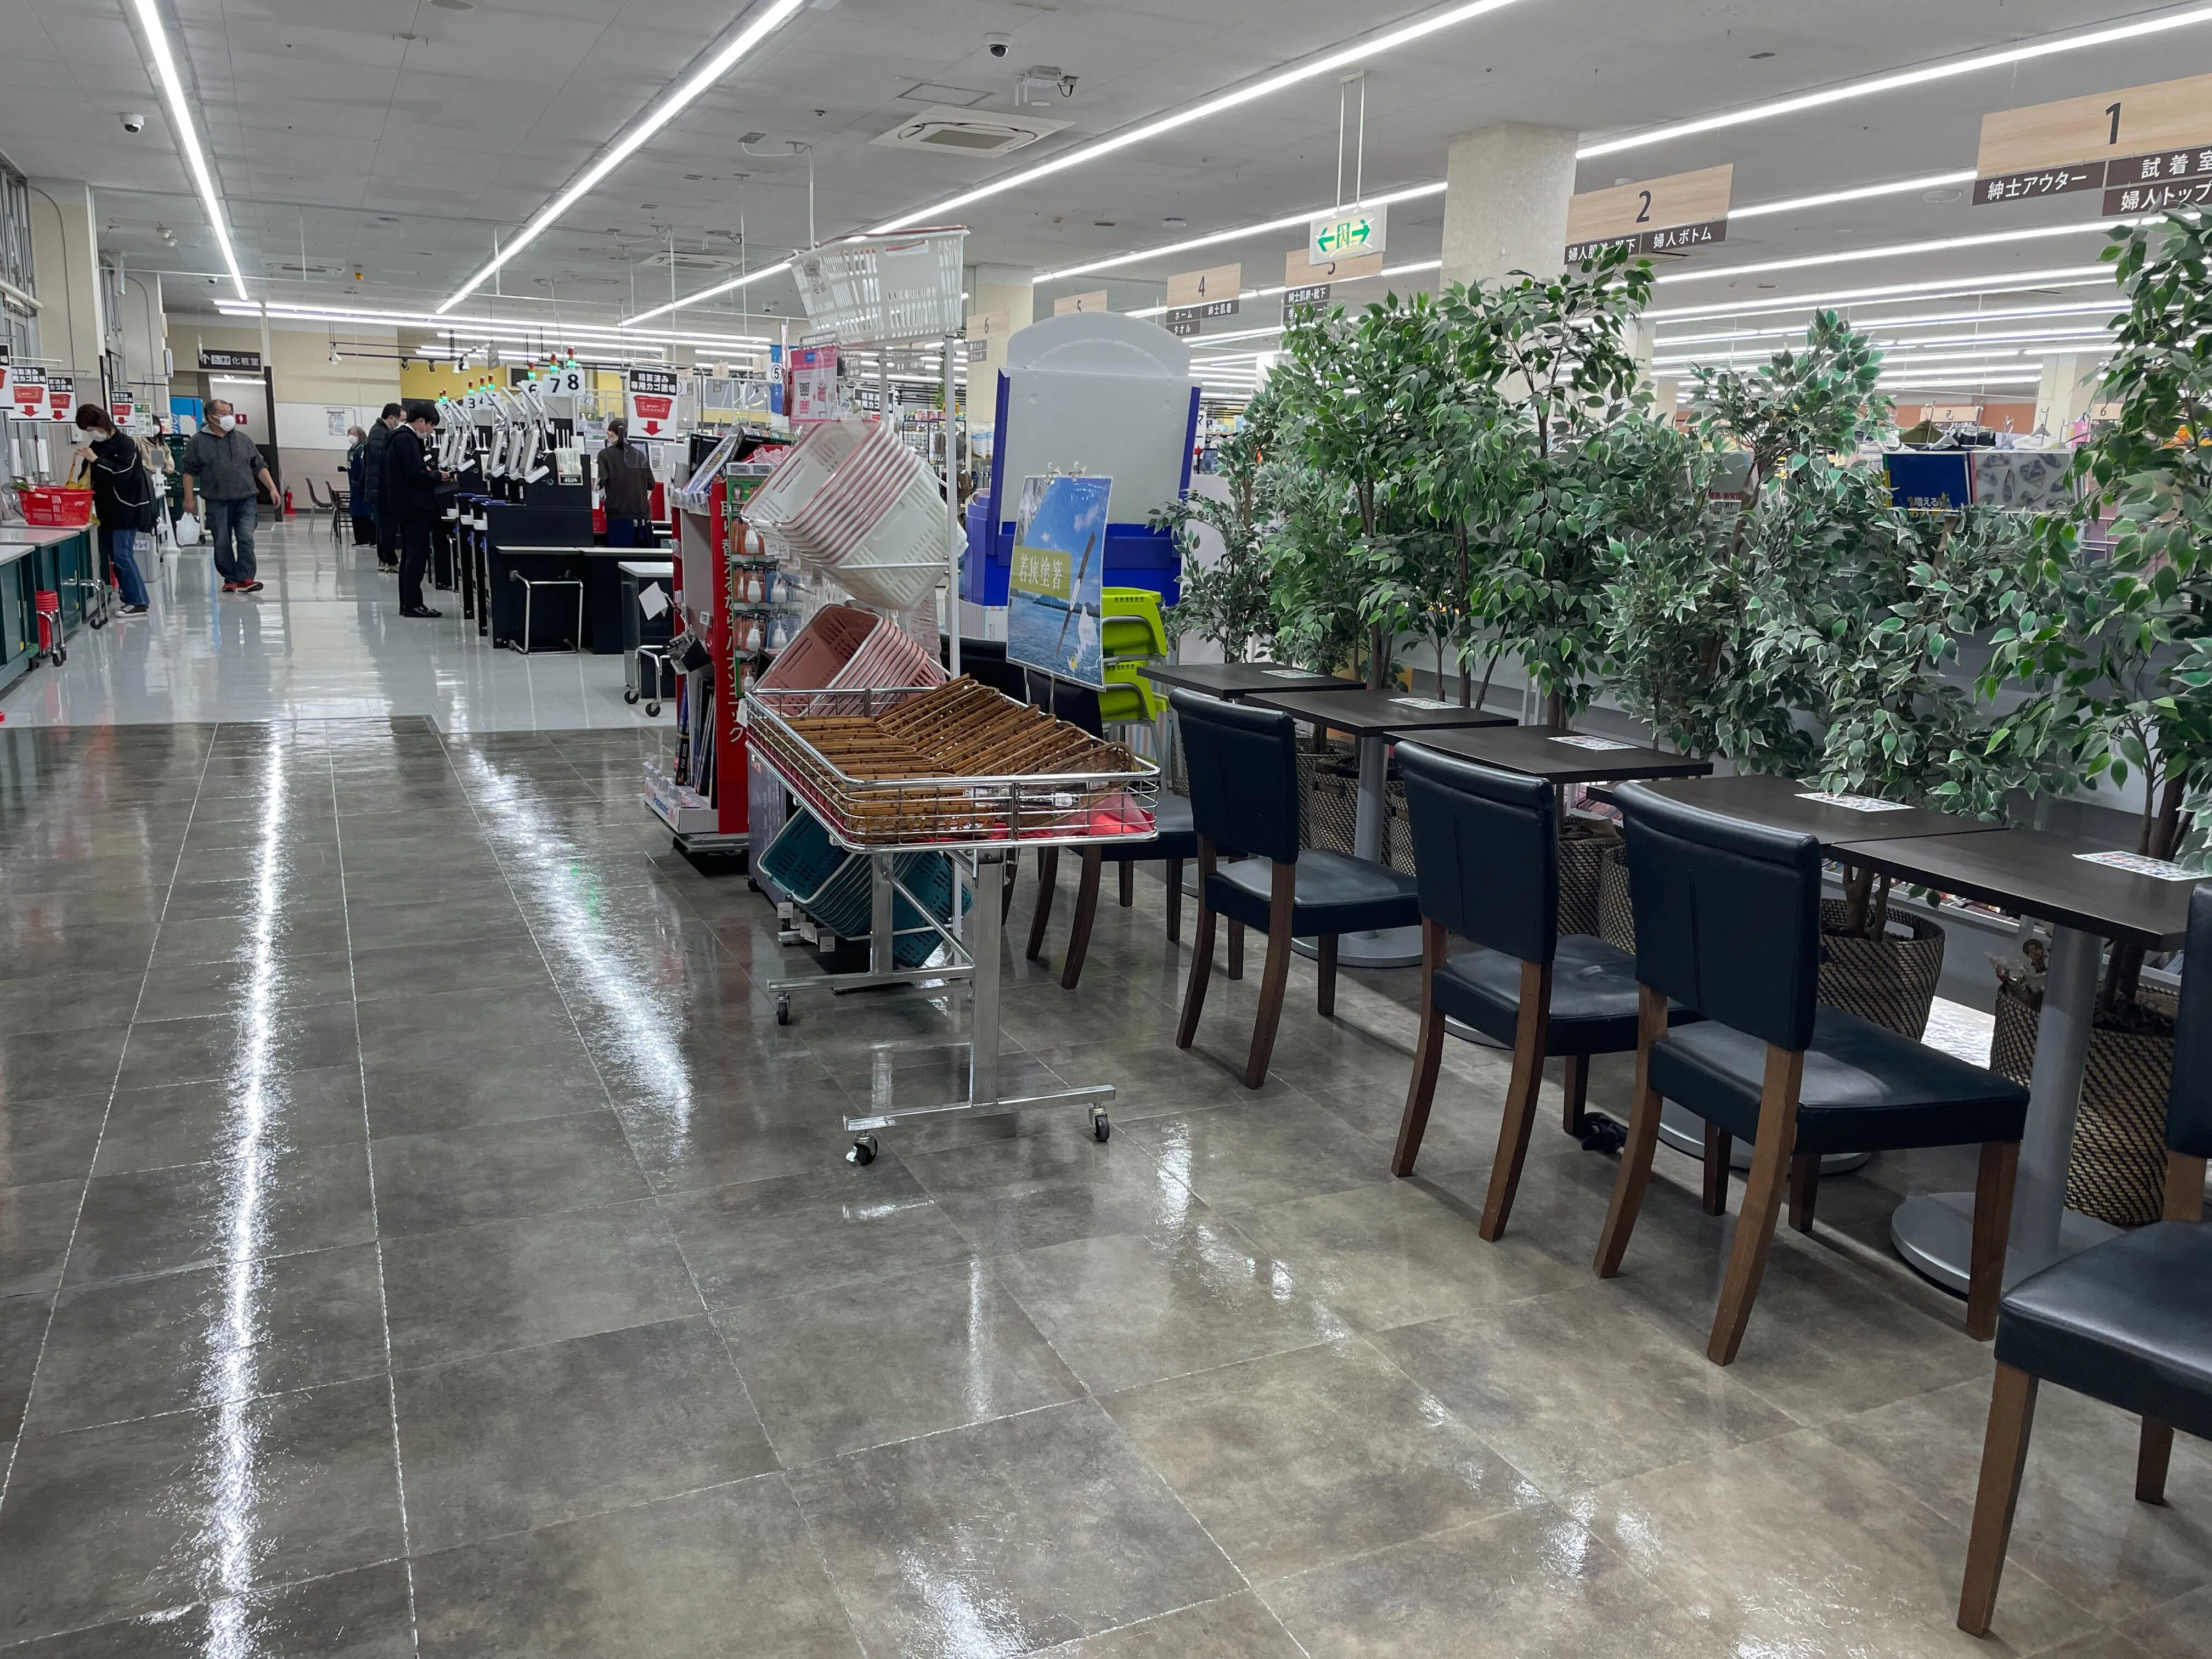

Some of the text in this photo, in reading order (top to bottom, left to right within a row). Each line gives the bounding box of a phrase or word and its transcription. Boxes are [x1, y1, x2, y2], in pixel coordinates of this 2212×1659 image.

[2105, 102, 2121, 145] 1
[2141, 149, 2212, 180] 試着室
[1987, 171, 2087, 201] 紳士アウター
[1636, 190, 1651, 223] 2
[1654, 226, 1712, 249] 婦人ボトム
[1198, 276, 1206, 297] 4
[1175, 311, 1193, 321] ホーム
[1207, 302, 1232, 316] 紳士肌着
[984, 317, 989, 334] 6
[1173, 324, 1191, 336] タオル
[550, 378, 561, 393] 7
[567, 374, 579, 390] 8
[638, 373, 669, 383] 精算済み
[631, 381, 676, 393] 専用カゴ置場
[469, 398, 476, 409] 3
[1019, 553, 1063, 591] 若狭塗箸
